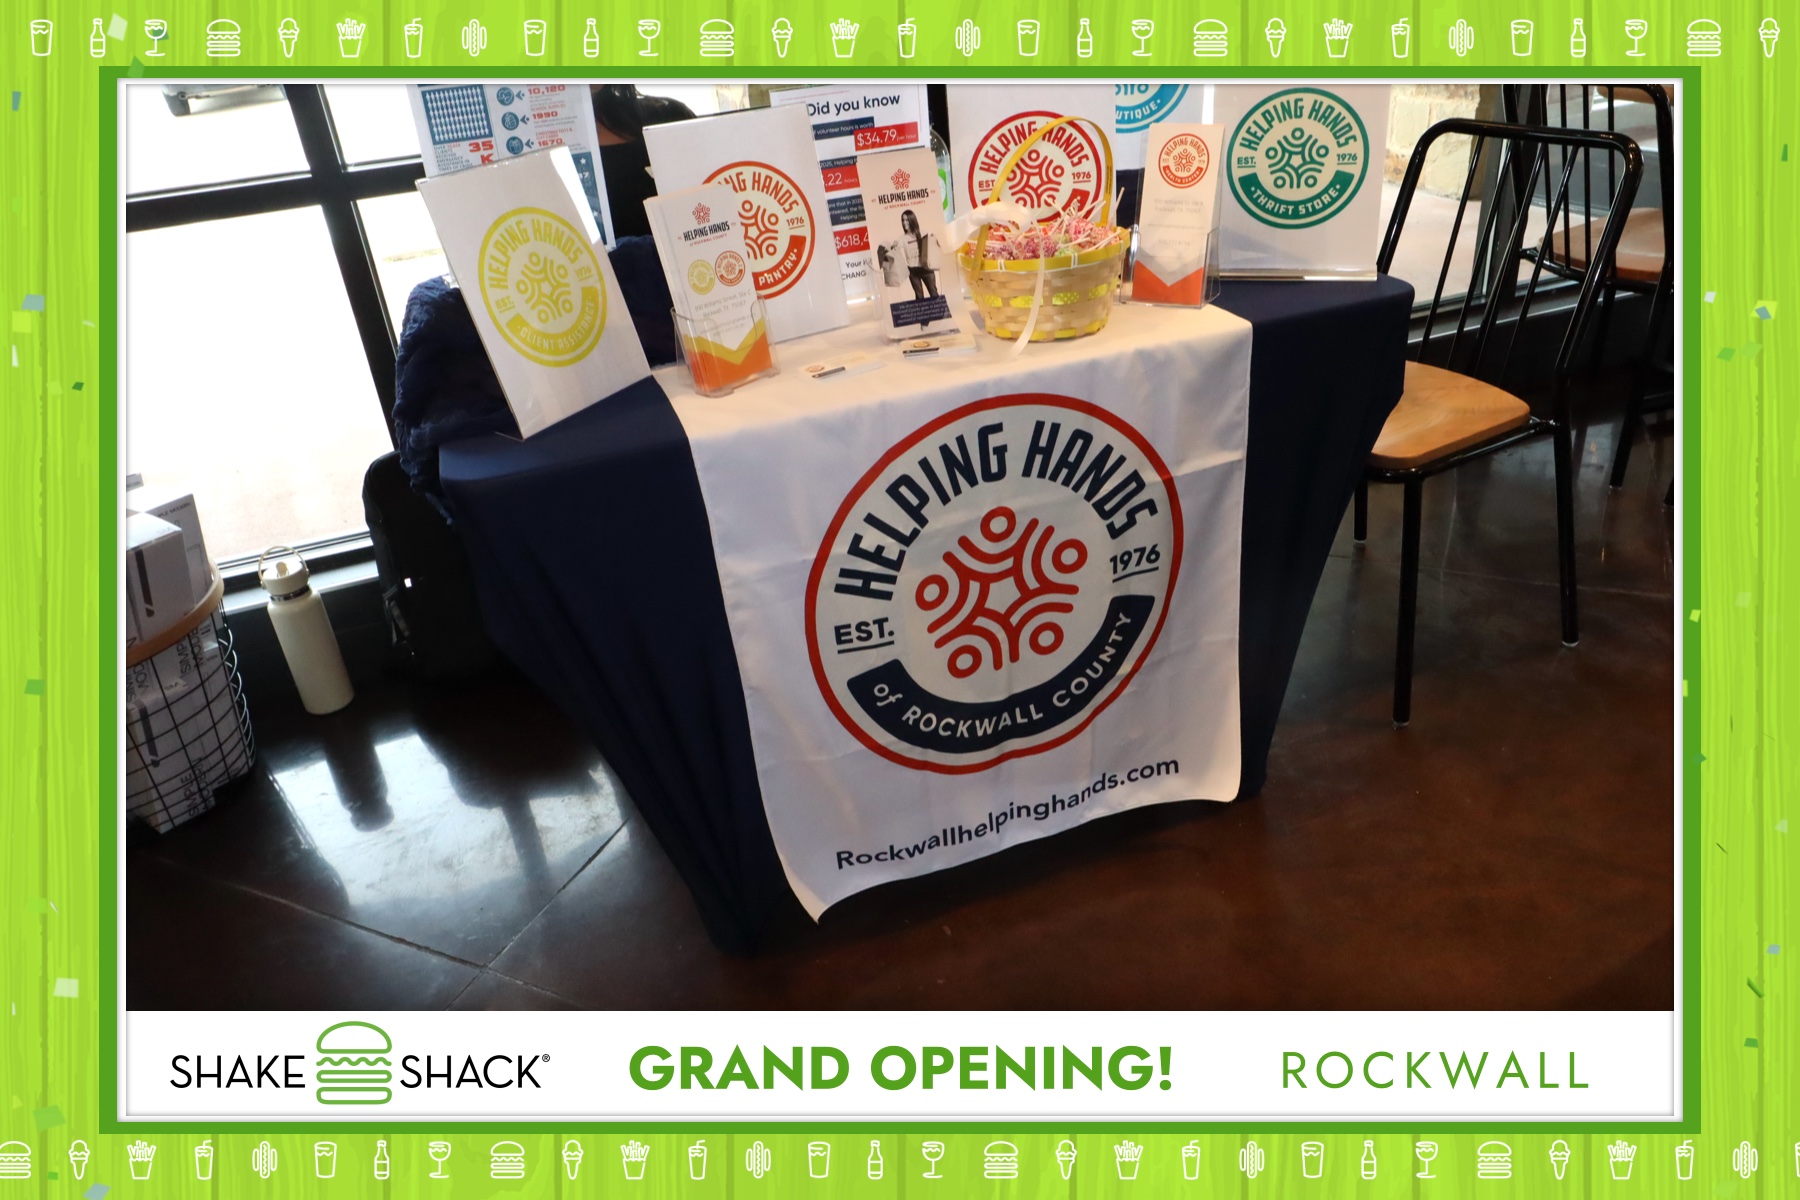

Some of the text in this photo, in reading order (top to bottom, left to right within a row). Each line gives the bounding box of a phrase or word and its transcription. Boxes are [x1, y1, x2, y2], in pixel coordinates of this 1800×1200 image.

[528, 85, 566, 95] 10,120
[532, 111, 558, 119] 1990
[808, 95, 900, 116] Did you know
[1116, 101, 1158, 120] UTIQUE
[817, 127, 839, 135] volunteer
[1239, 98, 1358, 152] HELPING HANDS
[468, 140, 494, 153] 35
[857, 128, 897, 147] $34.79
[1164, 137, 1206, 158] HELPING HANDS
[834, 158, 853, 167] Helping
[1237, 156, 1256, 165] EST.
[1336, 153, 1358, 162] 1976
[822, 172, 843, 187] .22
[1071, 171, 1091, 180] 1976
[751, 171, 799, 214] HANDS
[878, 188, 929, 205] HELPING HANDS
[1252, 187, 1339, 215] THRIFT STORE
[786, 216, 805, 227] 1976
[683, 221, 730, 242] HELPING HANDS
[488, 218, 583, 290] HELPING HANDS
[846, 259, 861, 268] Your
[842, 269, 866, 280] CHANG
[520, 299, 595, 350] CLIENT ASSISTANCE
[833, 420, 1159, 602] HELPING HANDS
[1110, 544, 1161, 575] 1976
[834, 617, 895, 646] EST.
[176, 642, 192, 675] SIMP
[873, 613, 1132, 738] of ROCKWALL COUNTY
[836, 759, 1180, 870] Rockwallhelpinghands.com
